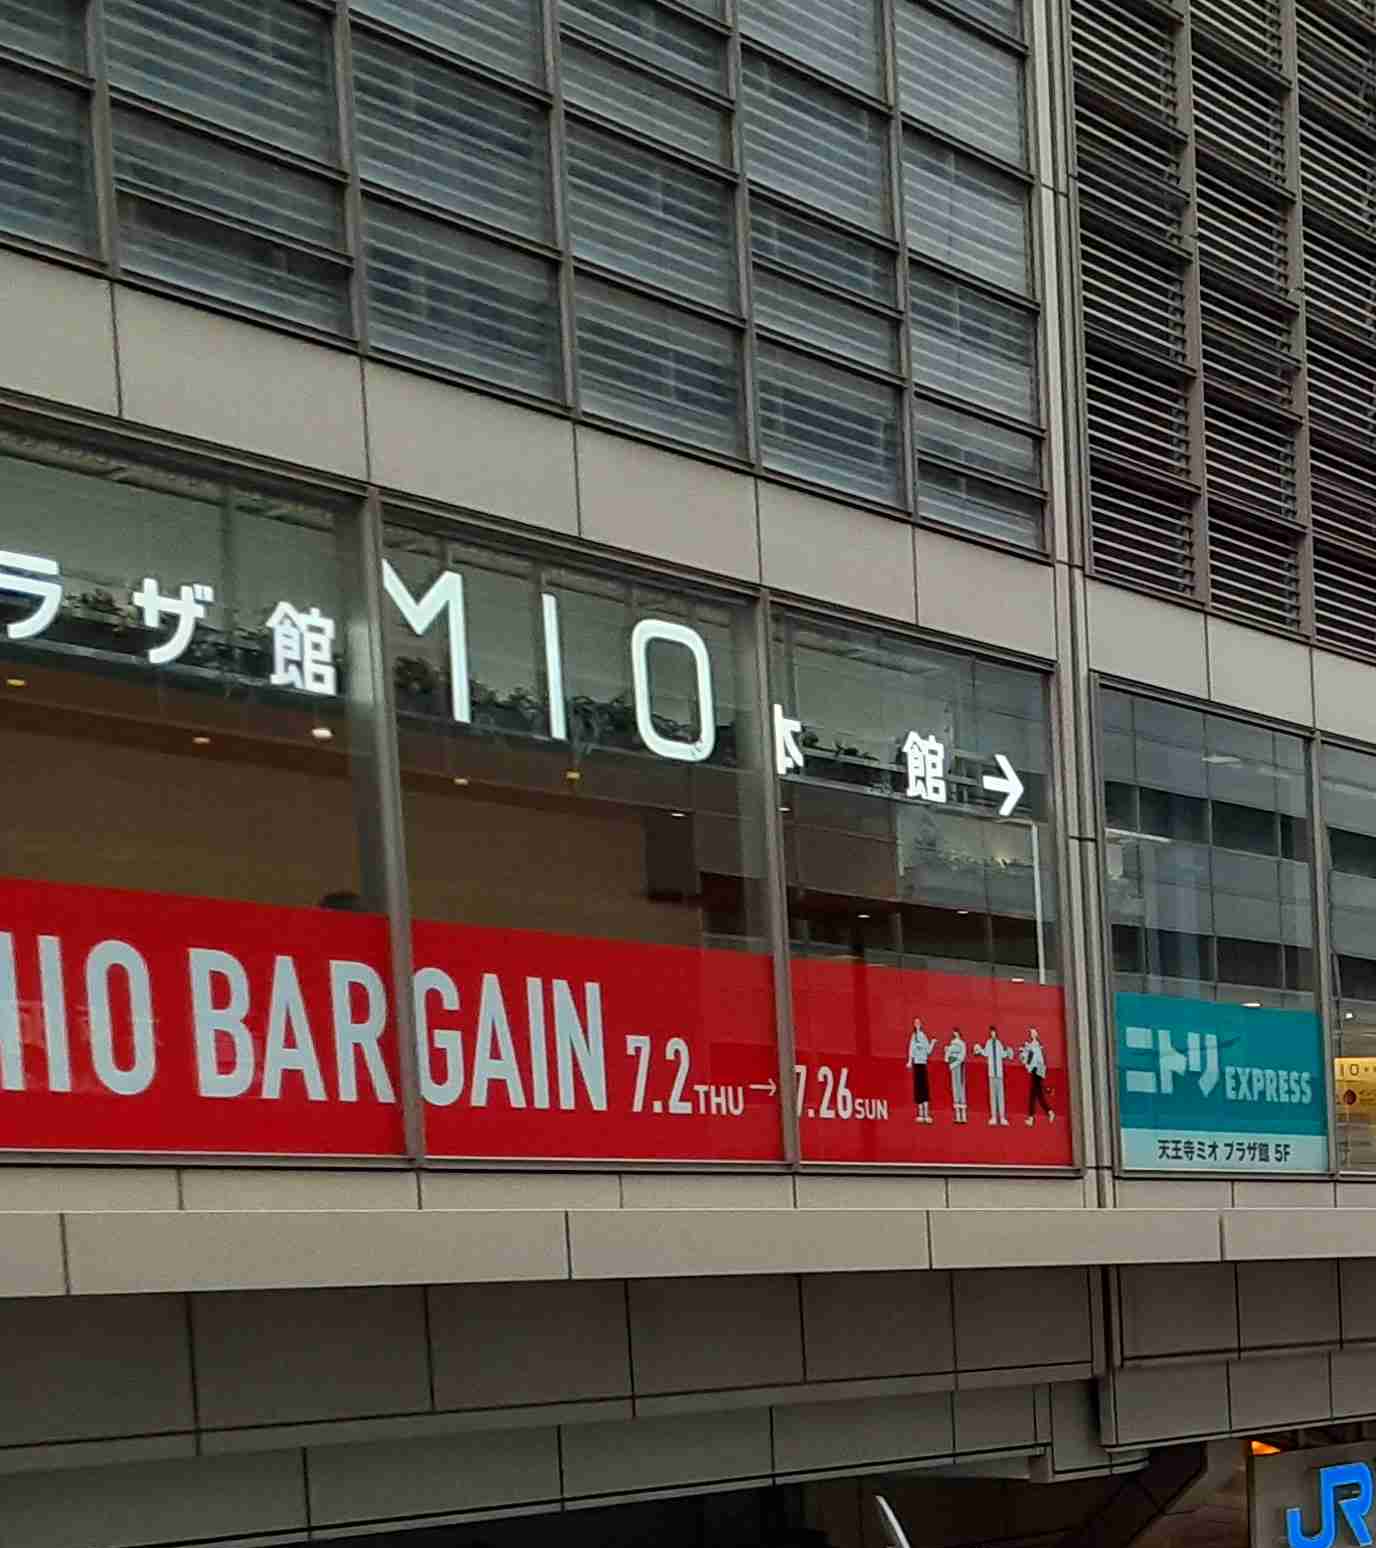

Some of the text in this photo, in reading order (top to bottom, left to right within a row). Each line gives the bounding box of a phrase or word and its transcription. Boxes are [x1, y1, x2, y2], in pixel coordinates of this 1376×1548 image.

[381, 558, 716, 763] MIO
[188, 946, 608, 1112] BARGAIN
[625, 1034, 693, 1114] 7.2
[693, 1084, 745, 1116] THU
[793, 1064, 852, 1120] 7.26
[854, 1098, 888, 1121] SUN
[1125, 1026, 1313, 1105] ニトリ EXPRESS
[1157, 1138, 1291, 1163] 天王寺ミオ プラザ館 5F
